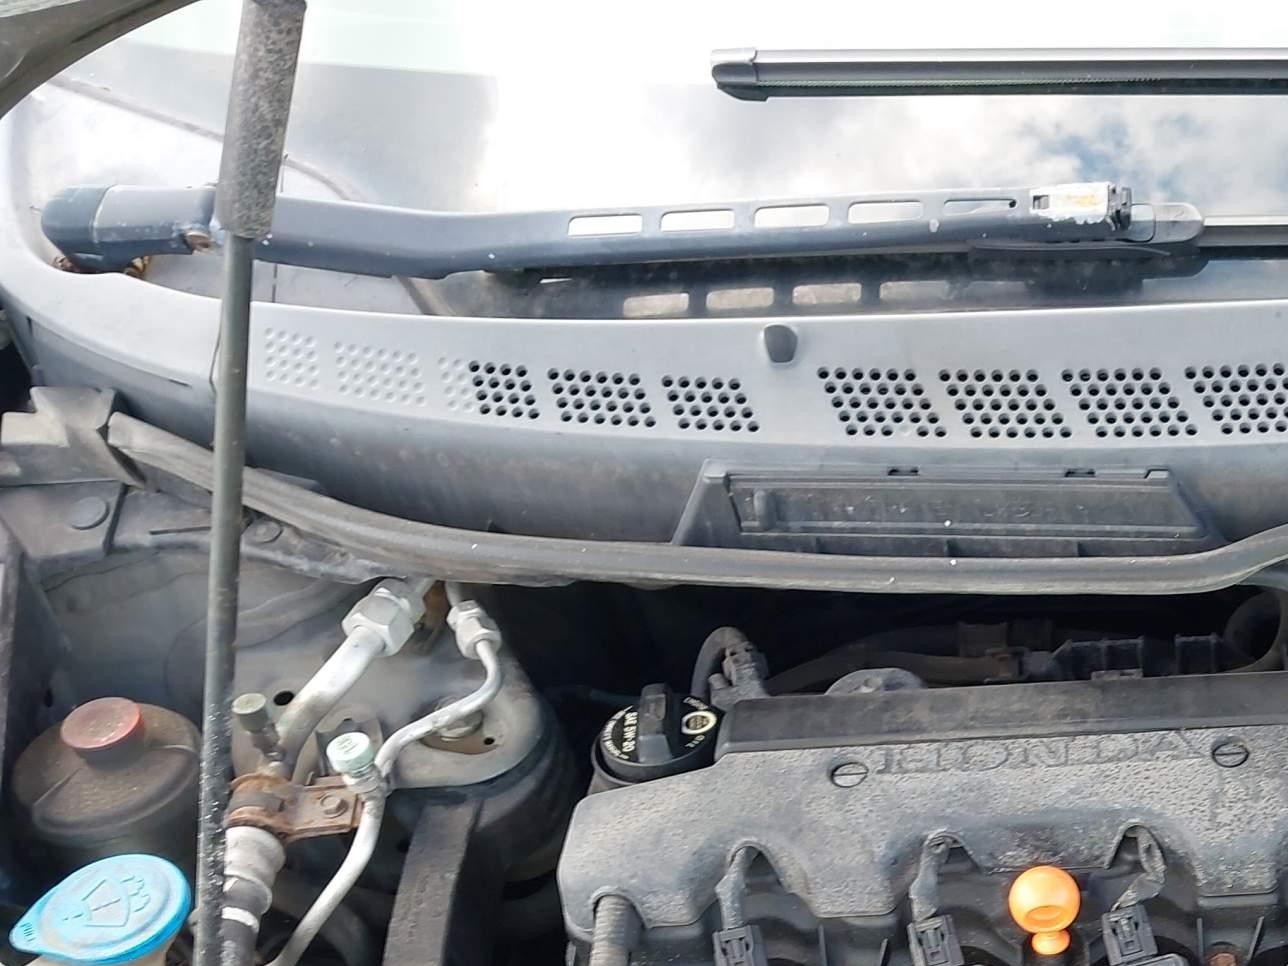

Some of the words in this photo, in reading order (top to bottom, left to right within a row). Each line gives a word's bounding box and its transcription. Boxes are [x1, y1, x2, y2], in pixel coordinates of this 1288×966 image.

[623, 711, 638, 726] SAE
[622, 726, 637, 752] 5W-20
[877, 729, 1203, 774] HONDA
